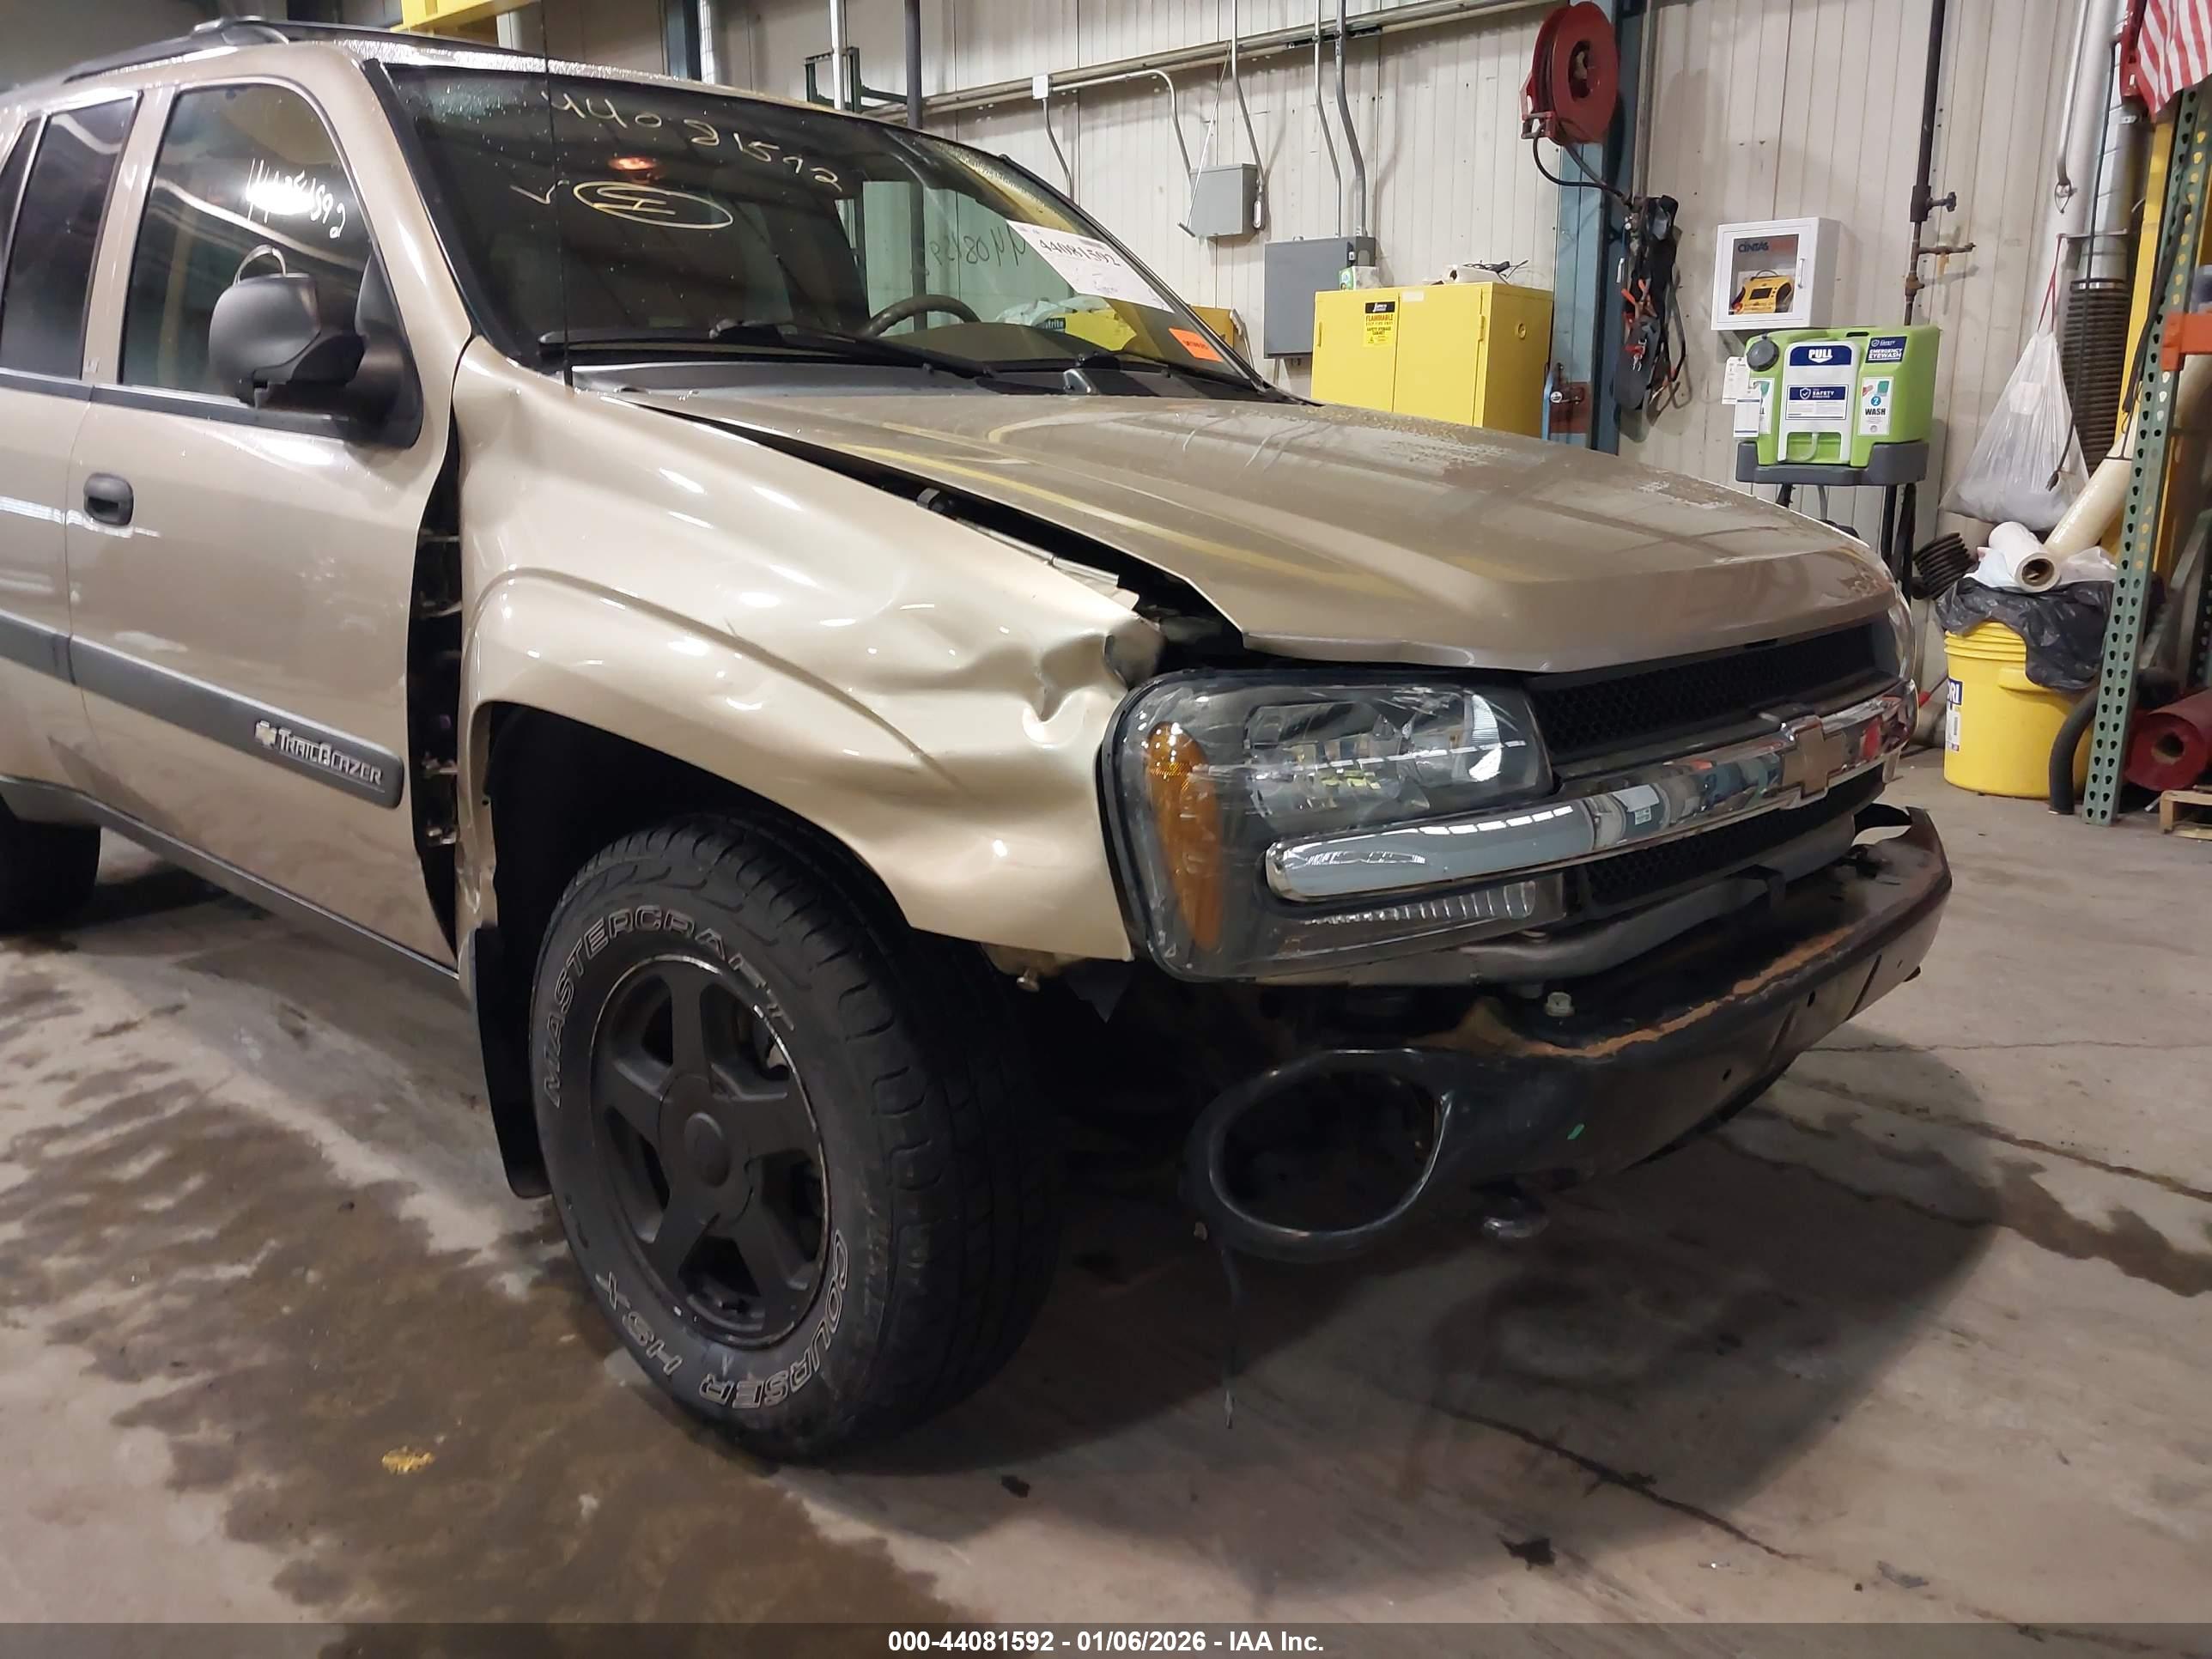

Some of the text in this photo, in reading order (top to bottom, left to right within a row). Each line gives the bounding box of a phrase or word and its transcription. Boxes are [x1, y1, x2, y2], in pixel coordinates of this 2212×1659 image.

[1039, 239, 1121, 267] 44081592
[1737, 241, 1770, 253] CINTAS
[1808, 349, 1833, 358] PULL
[1873, 397, 1880, 405] 2
[699, 1228, 849, 1409] COURSER
